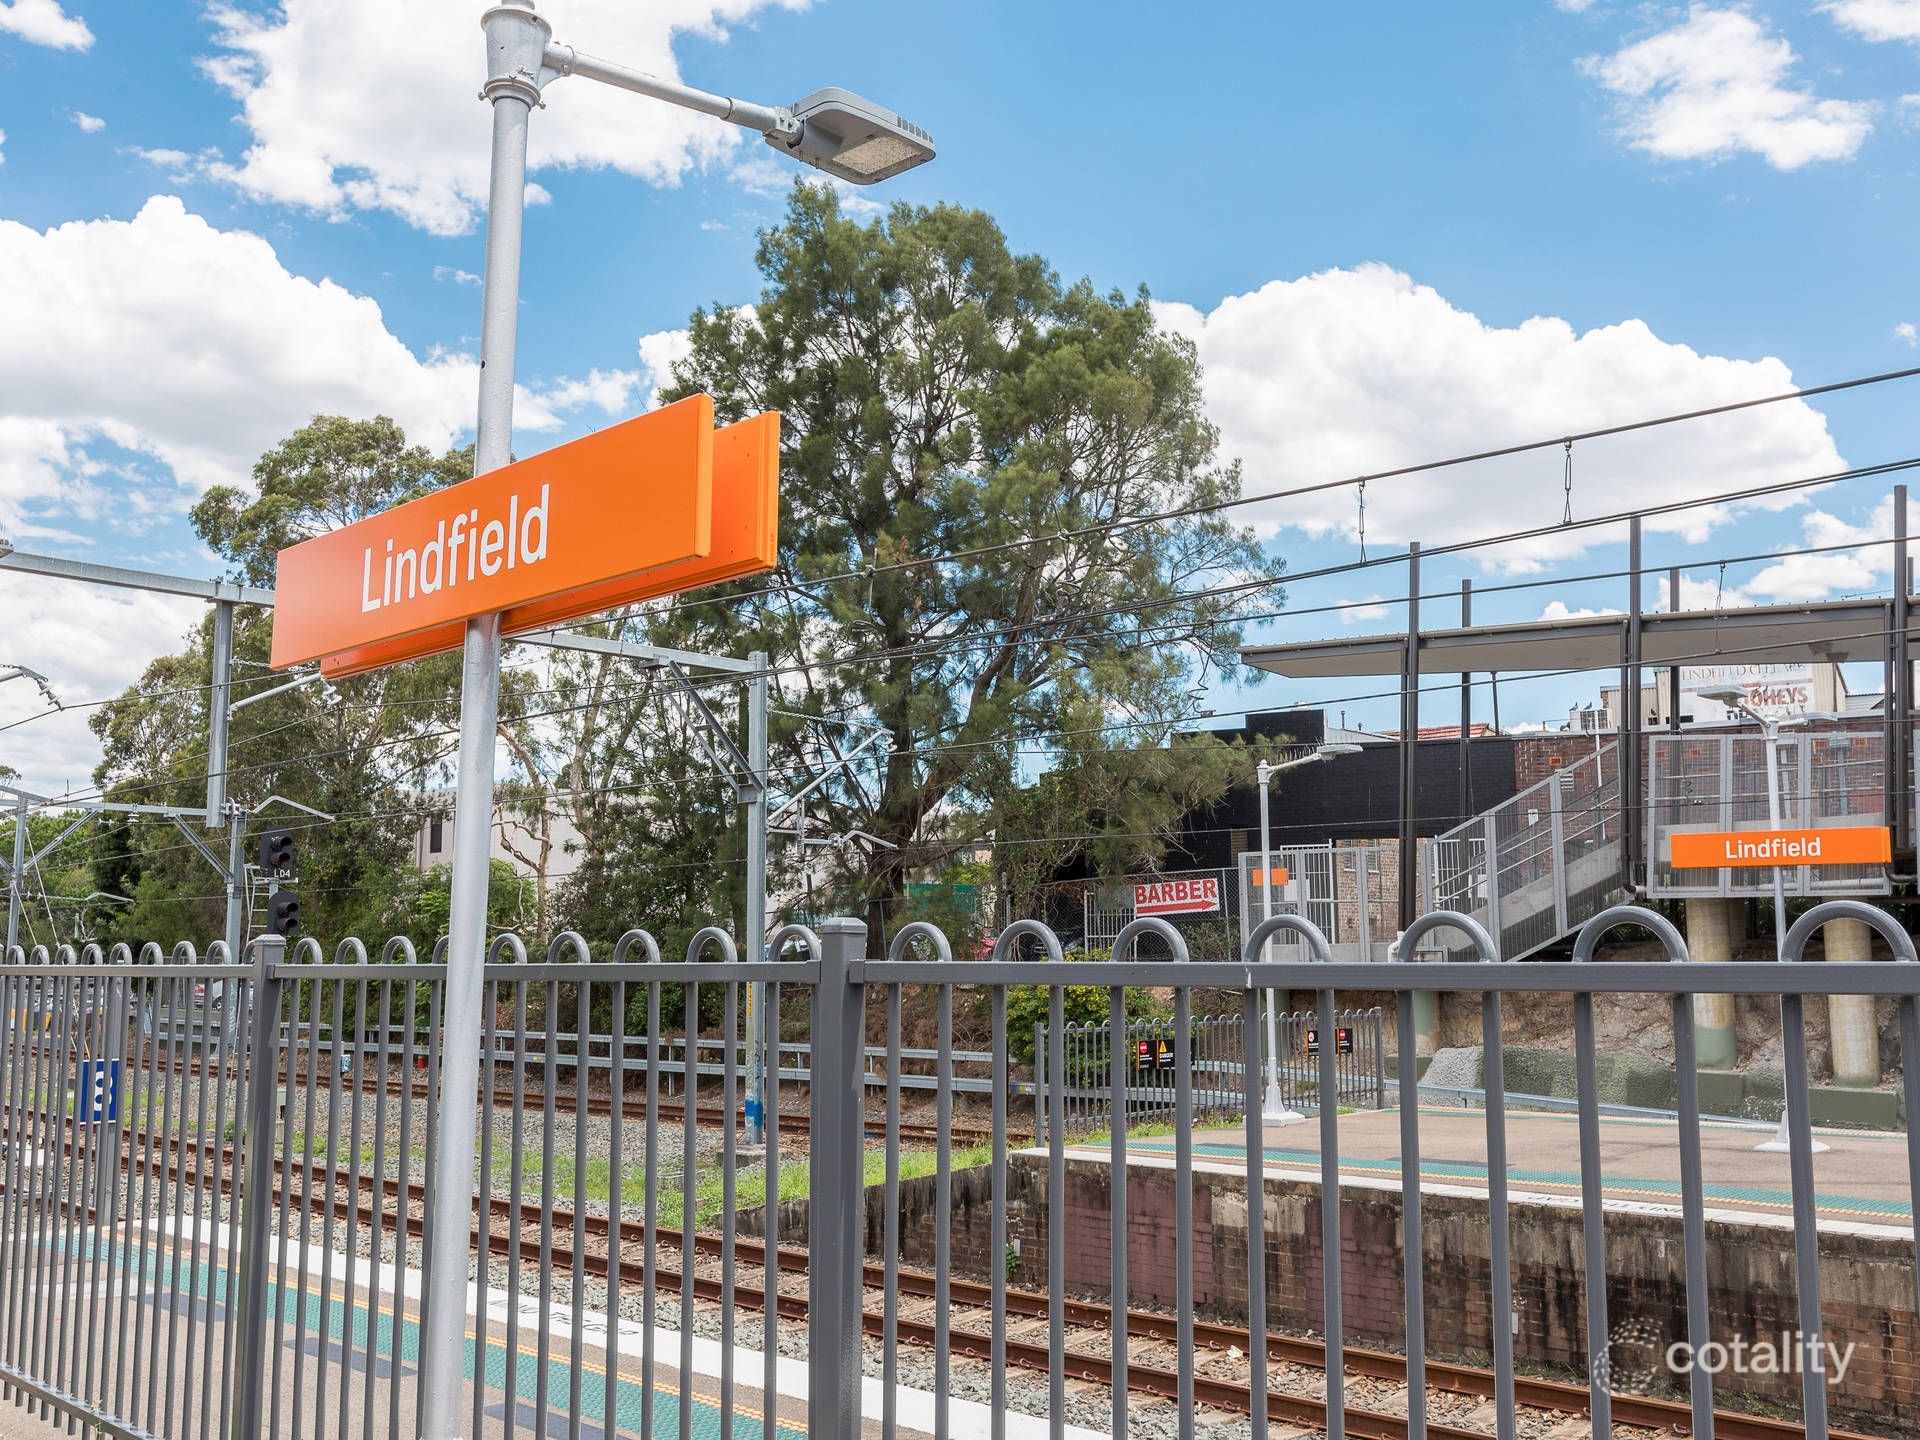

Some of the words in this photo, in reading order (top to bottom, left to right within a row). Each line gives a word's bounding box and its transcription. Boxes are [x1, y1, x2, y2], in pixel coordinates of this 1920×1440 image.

[361, 483, 550, 613] Lindfield
[1725, 837, 1821, 859] Lindfield
[1135, 879, 1217, 904] BARBER
